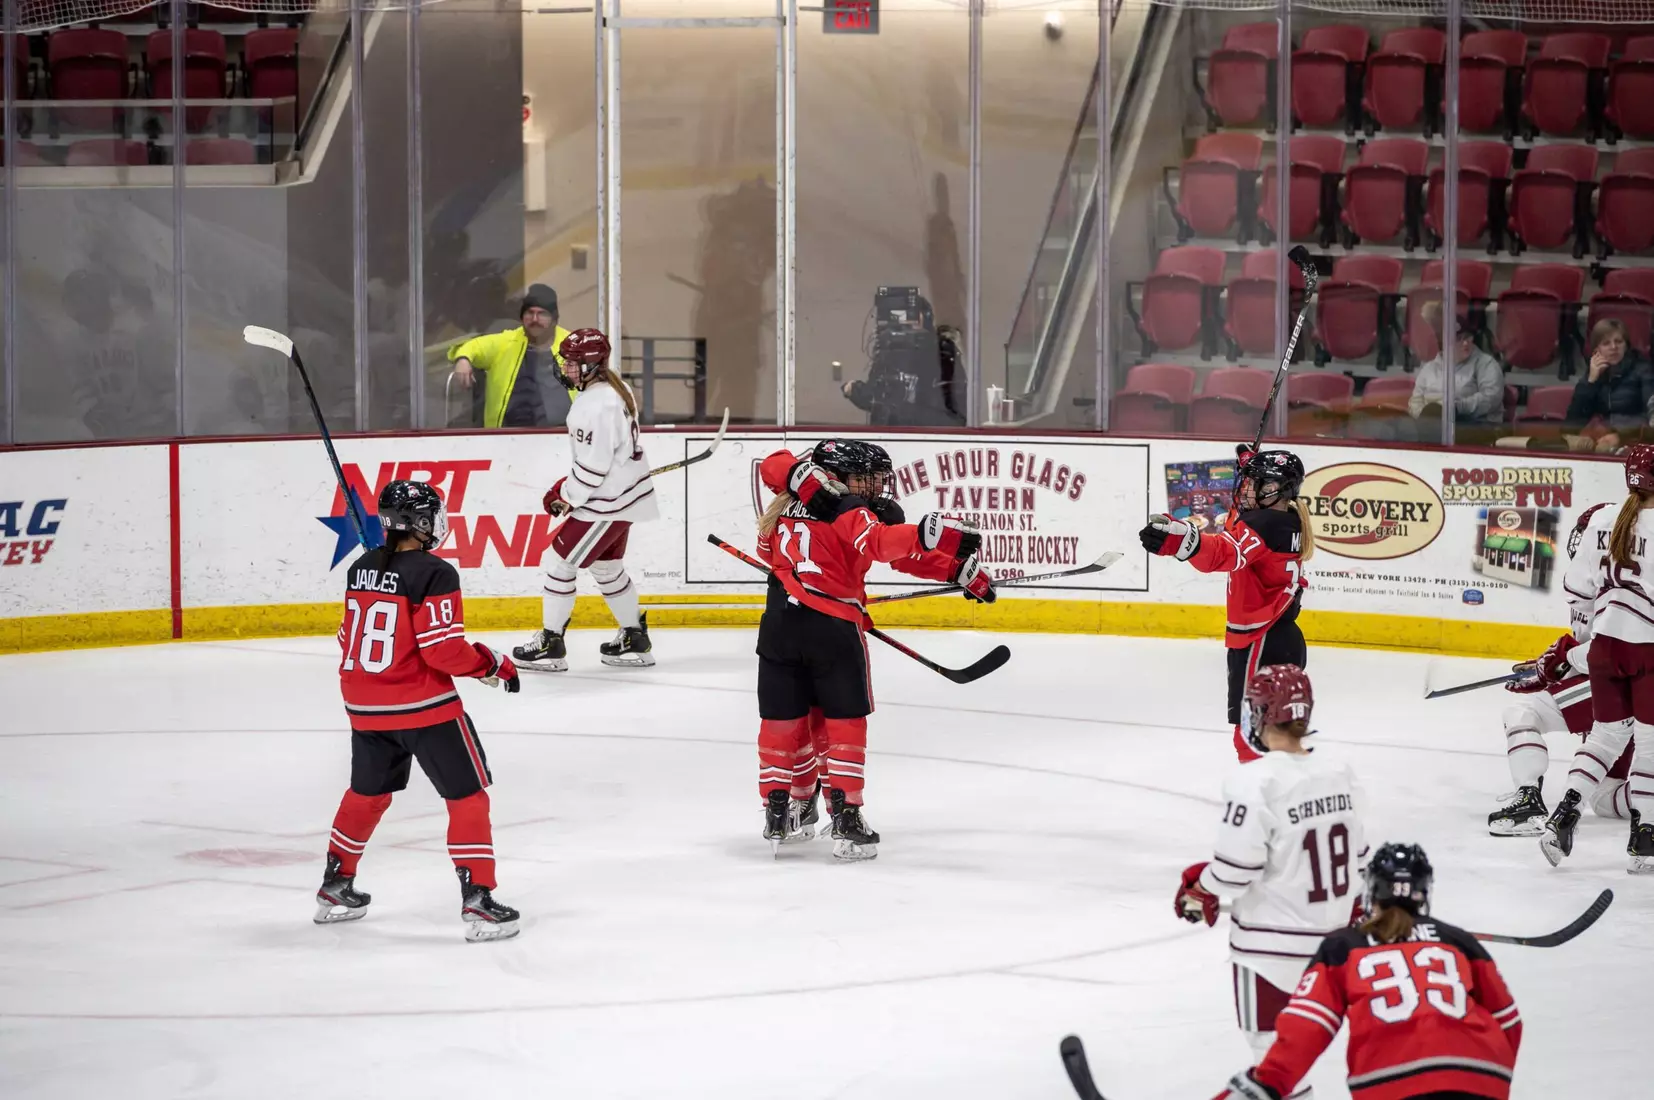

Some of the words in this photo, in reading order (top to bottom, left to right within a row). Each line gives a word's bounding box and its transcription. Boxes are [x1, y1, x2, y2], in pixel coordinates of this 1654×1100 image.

[1281, 314, 1305, 372] BAUER
[576, 428, 593, 446] 94
[890, 458, 931, 500] HE
[936, 447, 1000, 484] HOUR
[1010, 450, 1087, 502] GLASS
[1442, 468, 1499, 485] FOOD
[1502, 467, 1573, 485] DRINK
[1629, 474, 1640, 486] 26
[934, 485, 1036, 512] TAVERN
[1298, 495, 1433, 523] RECOVERY
[1442, 484, 1515, 501] SPORTS
[1515, 484, 1573, 508] FUN
[1019, 513, 1037, 531] ST.
[1322, 522, 1370, 536] sports
[1375, 524, 1408, 538] grill
[1027, 535, 1079, 564] HOCKEY
[994, 568, 1025, 580] 1980
[1315, 570, 1353, 580] VERONA,
[1377, 574, 1401, 582] YORK
[425, 599, 453, 627] 18
[343, 598, 399, 675] 18
[1290, 703, 1306, 719] 18
[1222, 800, 1248, 827] 18
[1302, 822, 1350, 904] 18
[1357, 946, 1468, 1024] 33
